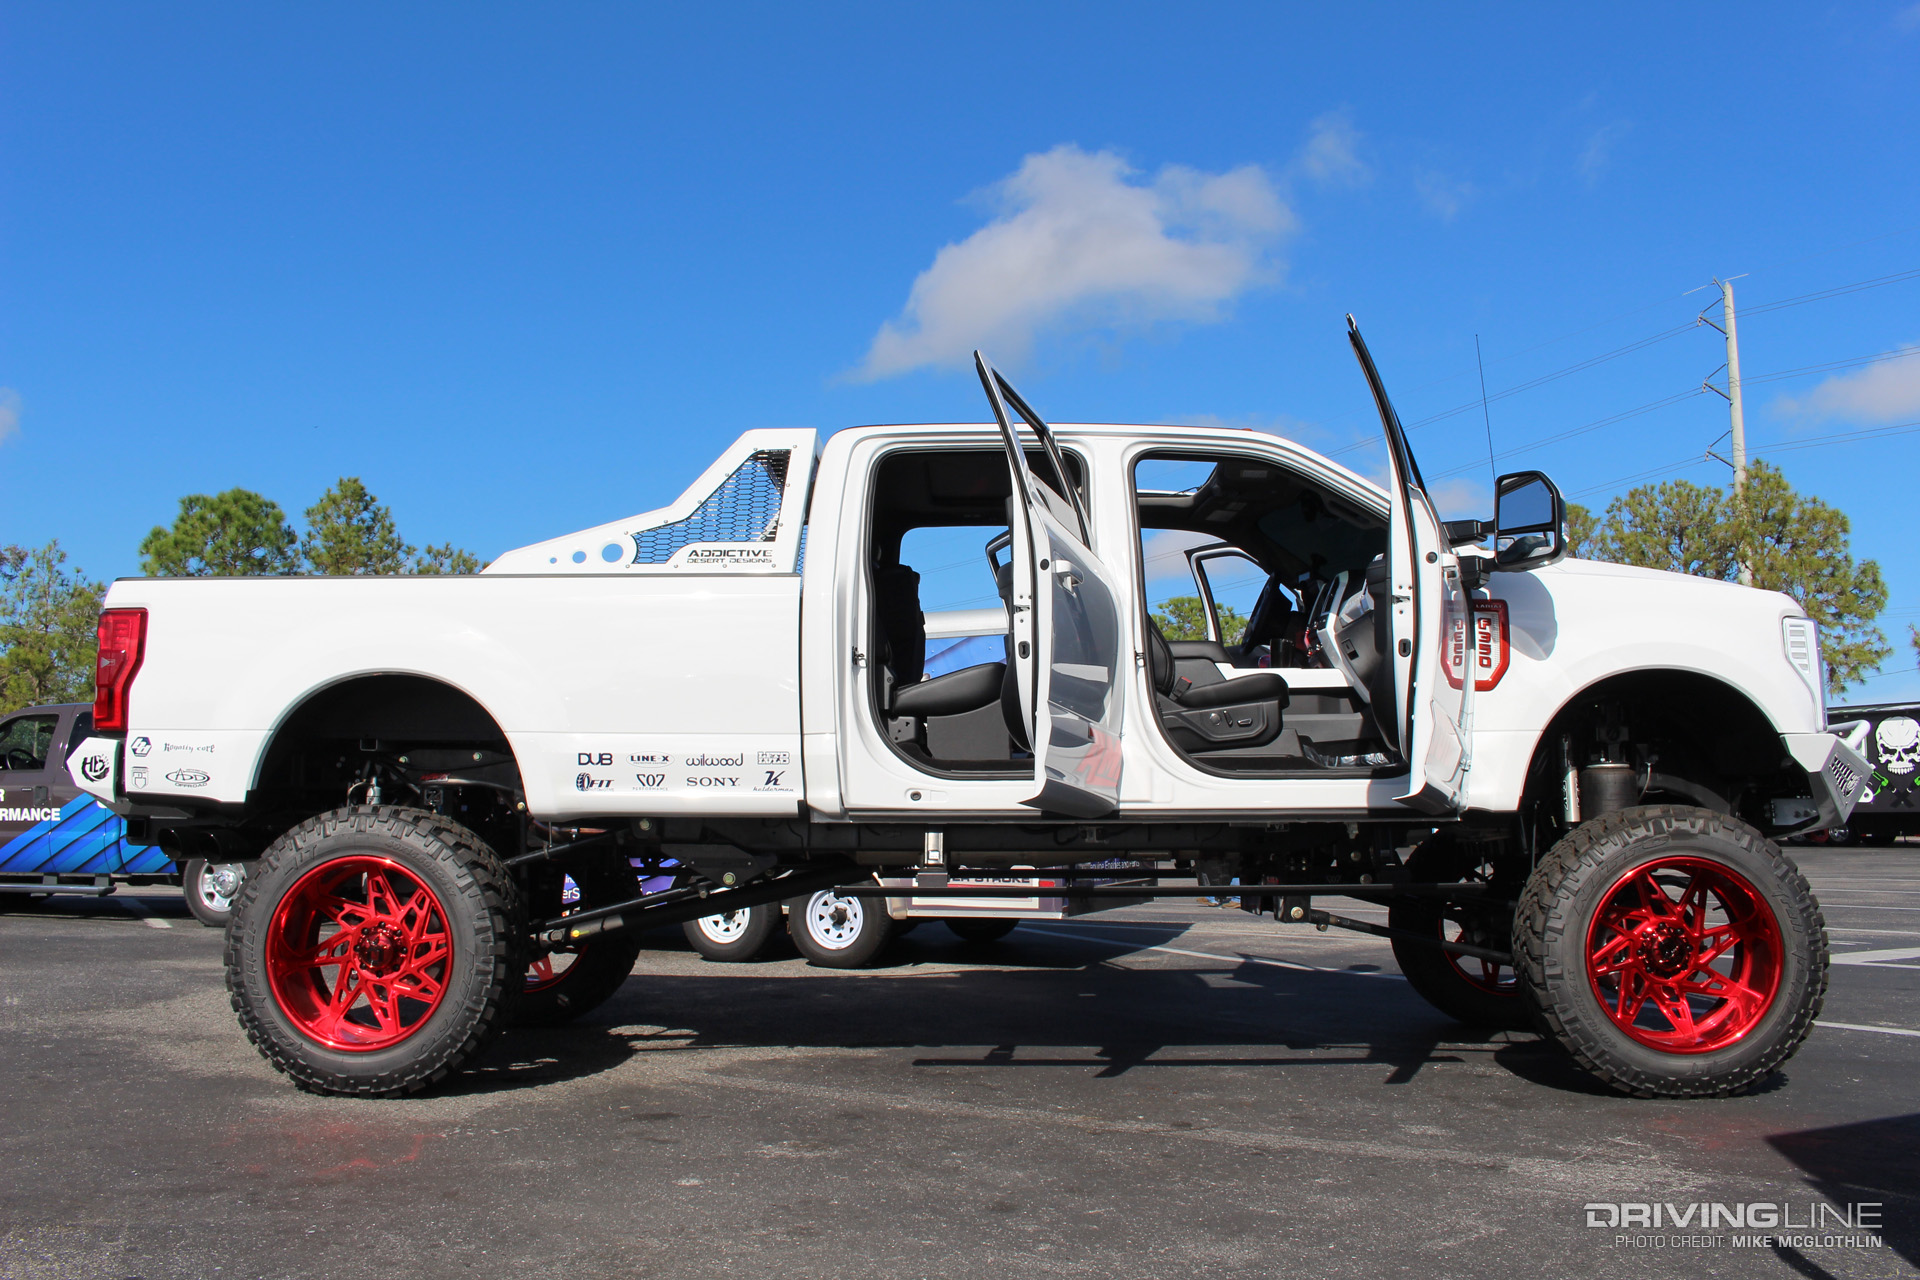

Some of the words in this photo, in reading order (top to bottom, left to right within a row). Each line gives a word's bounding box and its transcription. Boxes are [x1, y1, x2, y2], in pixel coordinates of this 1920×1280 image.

[688, 549, 773, 557] ADDICTIVE
[578, 752, 614, 766] DUB
[686, 752, 744, 767] wilwood
[686, 776, 741, 787] SONY
